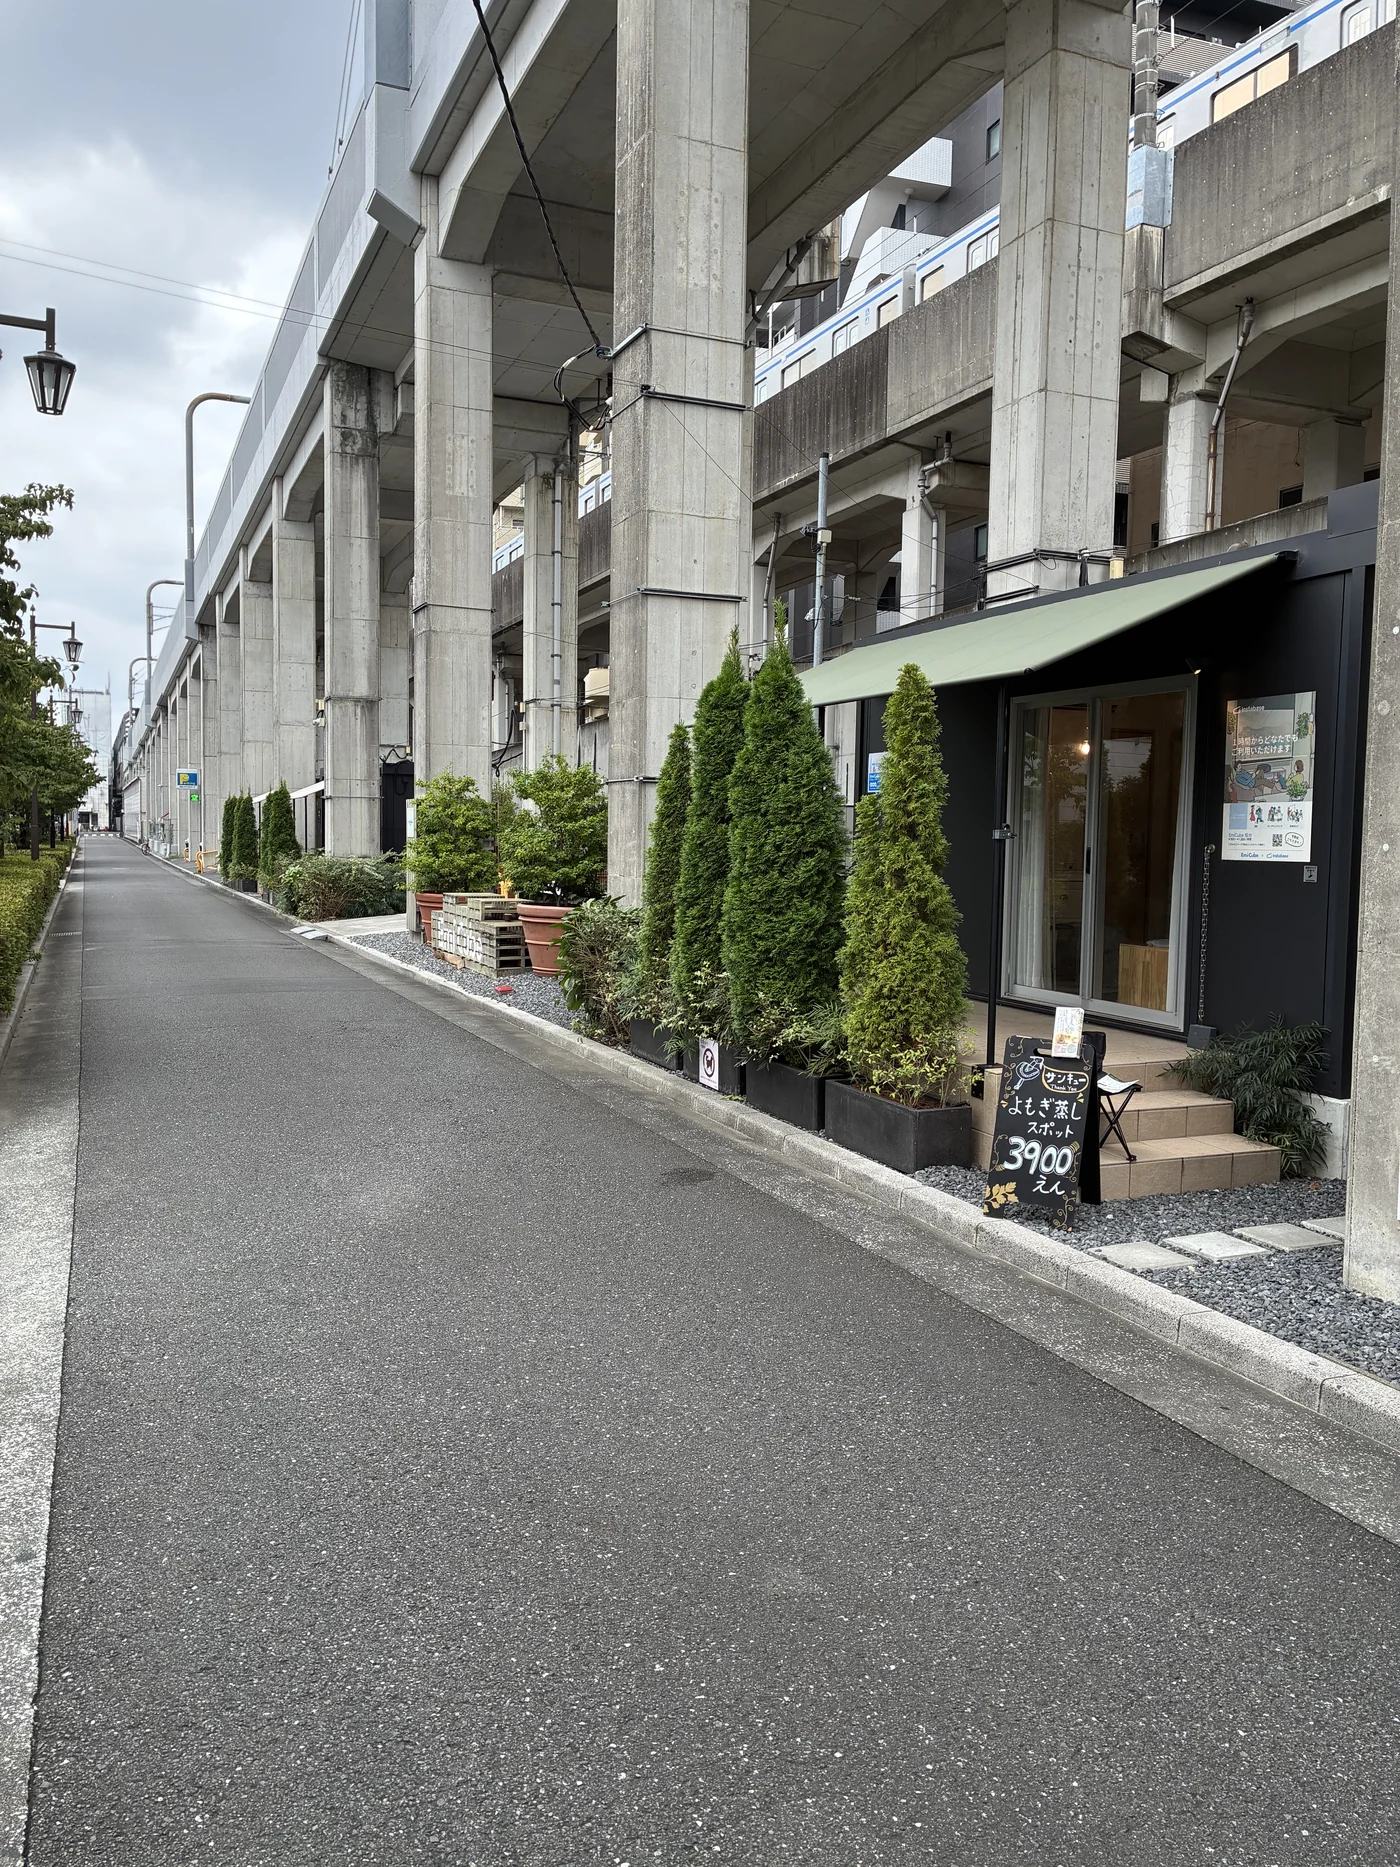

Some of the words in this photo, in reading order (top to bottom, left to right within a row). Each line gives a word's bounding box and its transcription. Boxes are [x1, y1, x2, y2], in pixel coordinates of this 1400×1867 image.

[1231, 745, 1292, 756] ご利用いただけます
[1045, 1072, 1087, 1085] サンキュー
[1050, 1083, 1067, 1091] Thank
[1008, 1096, 1082, 1121] よもぎ蒸し
[1027, 1121, 1074, 1138] スポット
[1003, 1135, 1075, 1176] 3900
[1032, 1175, 1066, 1195] えん
